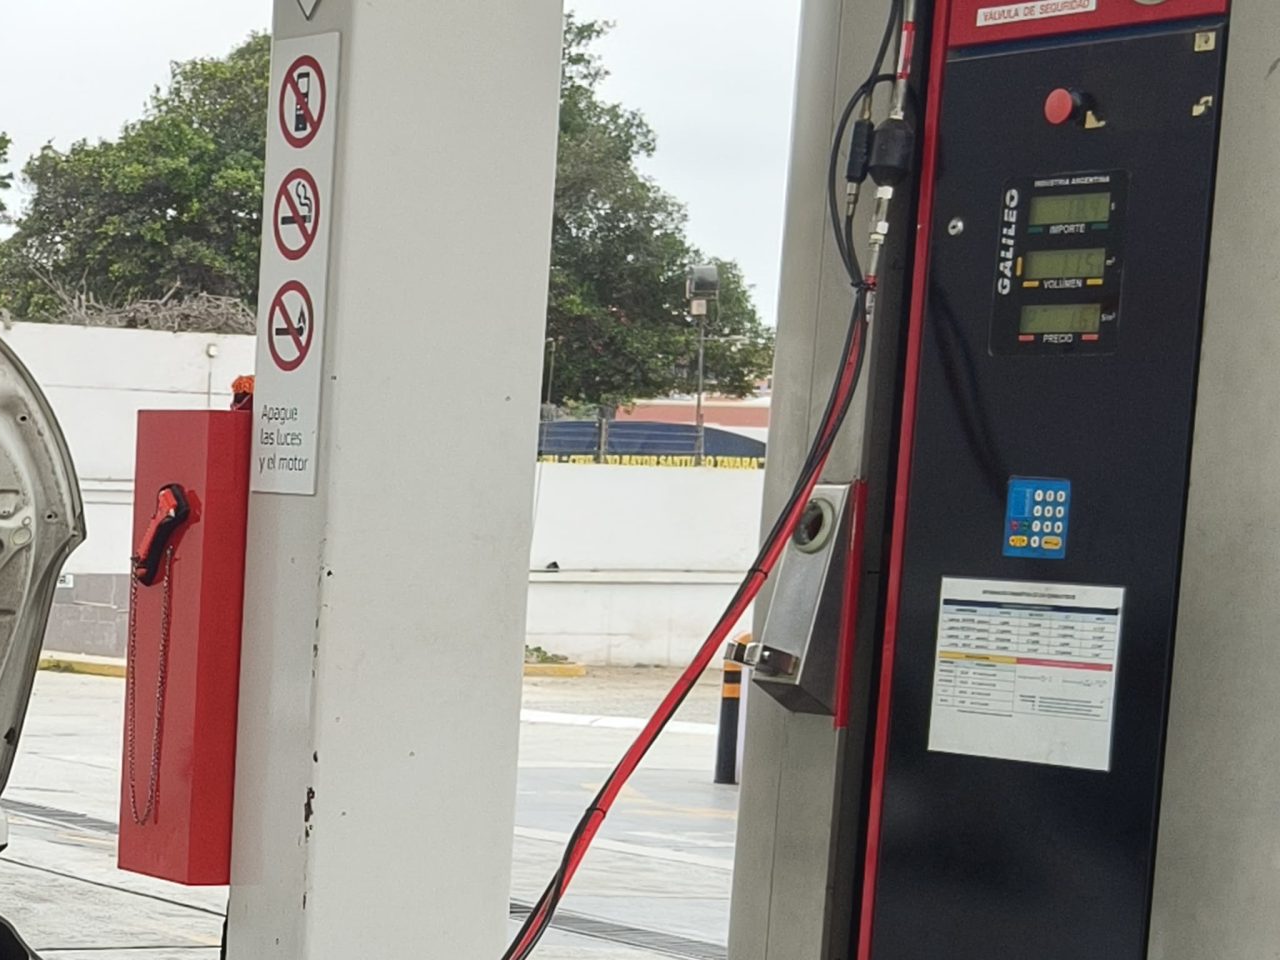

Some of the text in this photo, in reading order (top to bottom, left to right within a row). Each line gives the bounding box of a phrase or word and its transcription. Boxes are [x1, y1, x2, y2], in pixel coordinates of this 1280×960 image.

[997, 188, 1019, 295] GALILEO
[1042, 333, 1073, 344] PRECIO
[261, 404, 298, 425] Apague
[260, 428, 302, 447] las luces
[259, 453, 308, 474] y el motor
